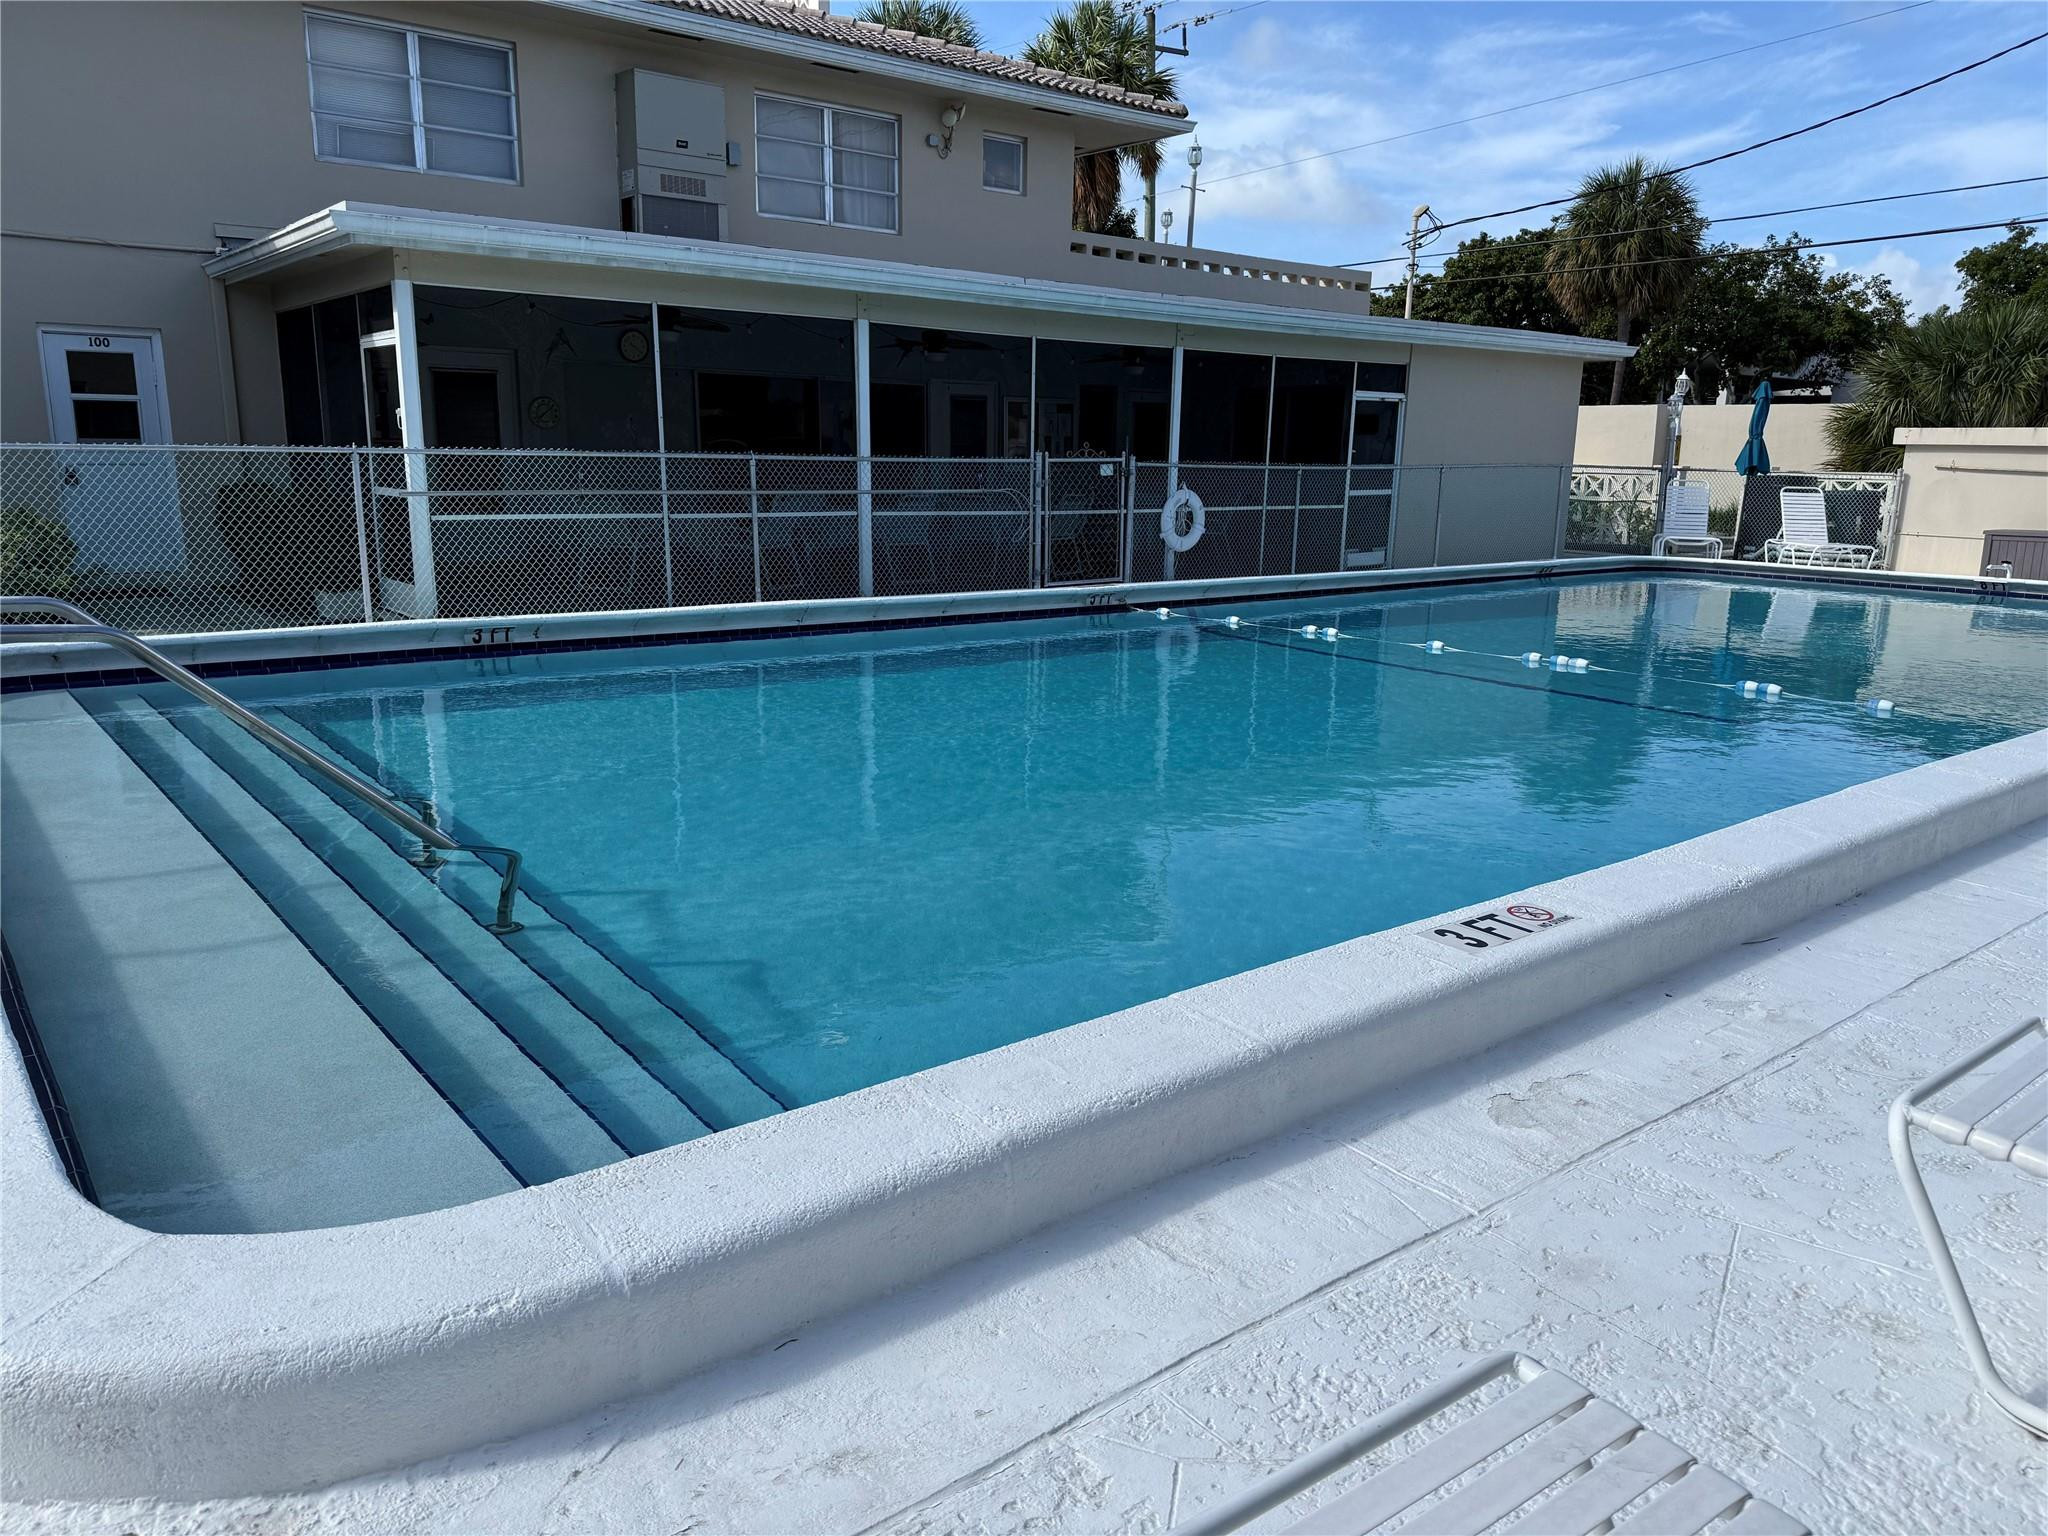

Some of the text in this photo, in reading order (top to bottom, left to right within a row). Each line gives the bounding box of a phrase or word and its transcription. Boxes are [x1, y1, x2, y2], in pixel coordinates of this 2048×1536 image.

[88, 336, 110, 348] 100
[1991, 582, 2006, 591] FT
[472, 626, 516, 644] 3 FT
[1434, 913, 1535, 948] 3 FT
